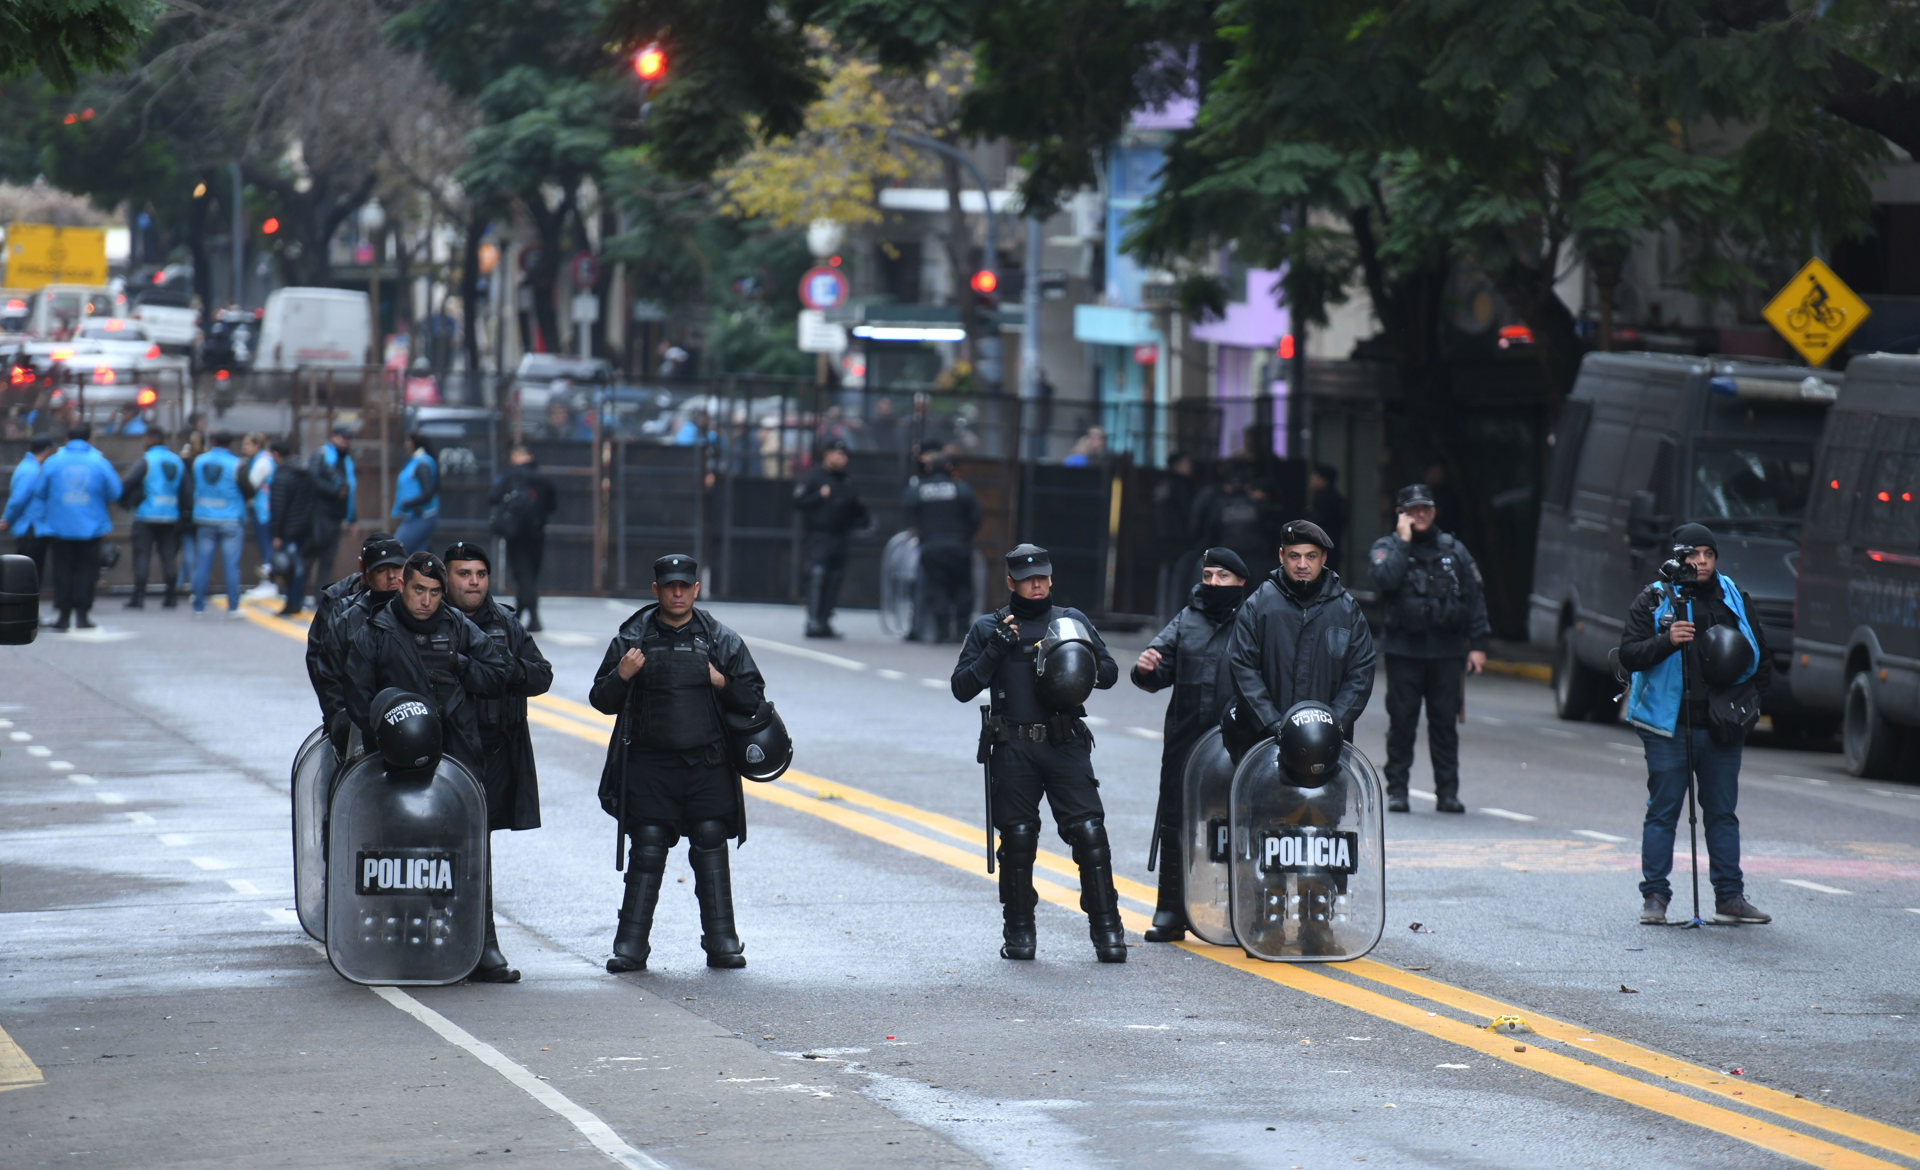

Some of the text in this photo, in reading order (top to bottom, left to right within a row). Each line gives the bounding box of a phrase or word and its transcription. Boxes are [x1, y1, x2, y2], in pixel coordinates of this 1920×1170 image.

[384, 704, 406, 719] CIUDAD
[386, 706, 429, 726] POLICIA
[1292, 713, 1334, 727] POLICIA
[1265, 836, 1351, 867] POLICIA
[363, 858, 453, 889] POLICIA
